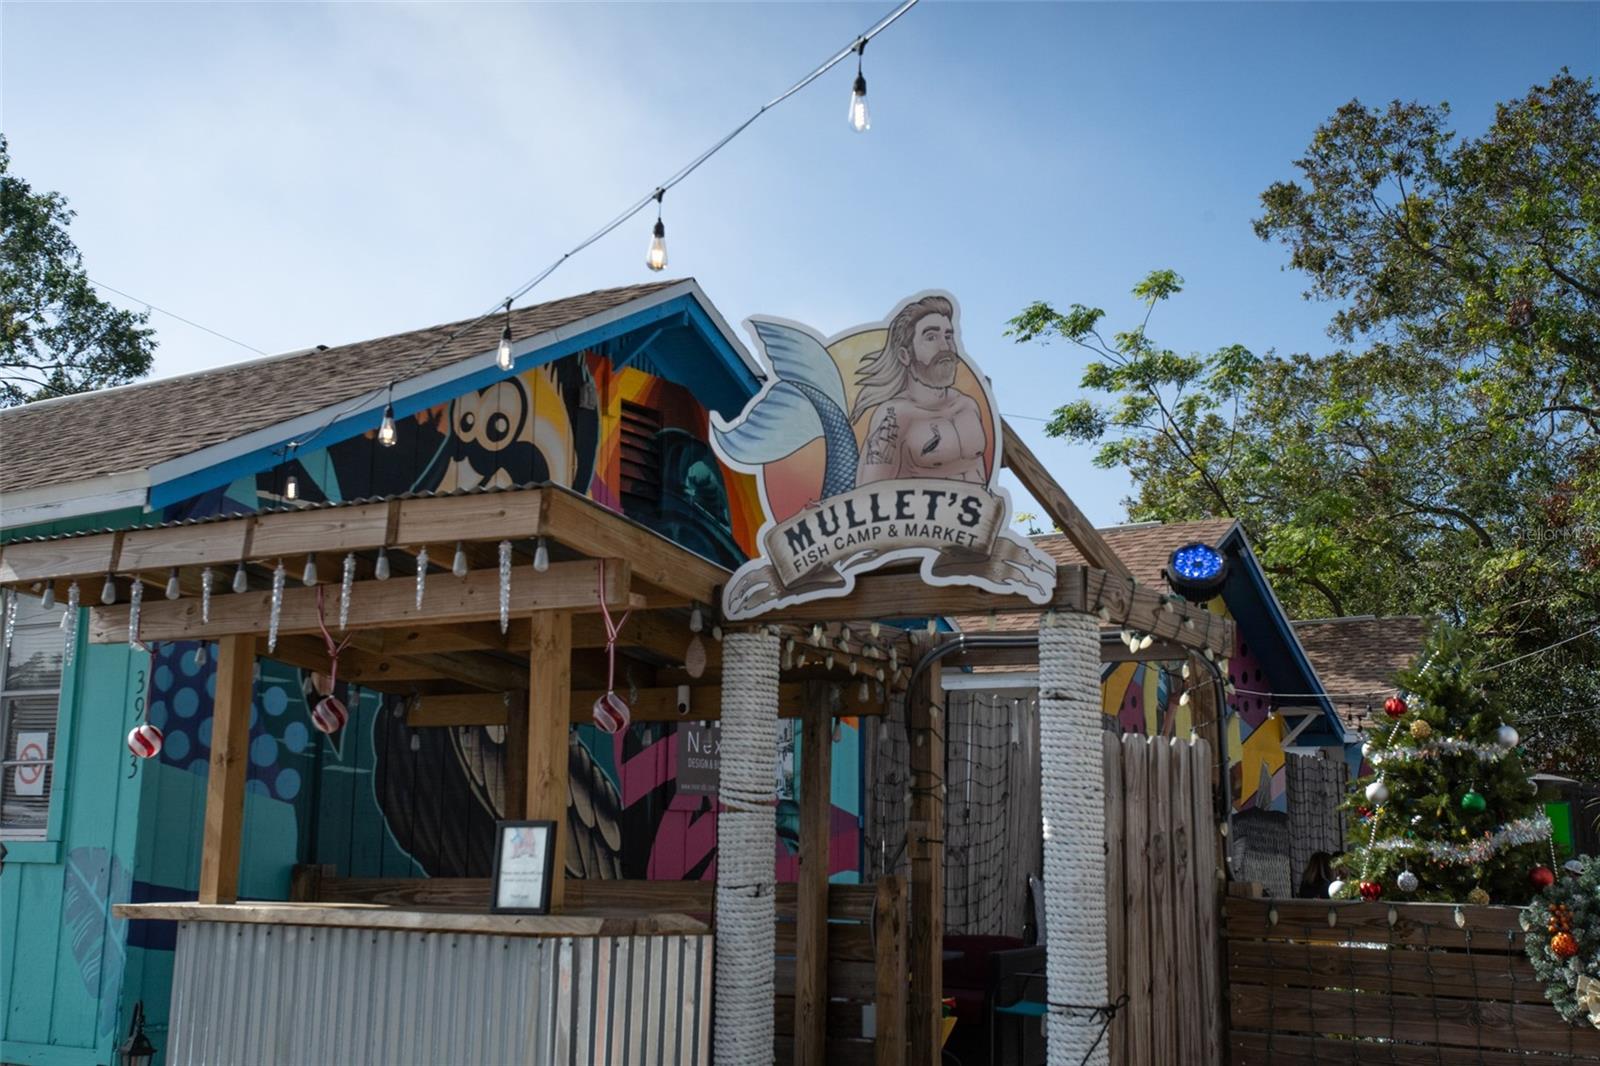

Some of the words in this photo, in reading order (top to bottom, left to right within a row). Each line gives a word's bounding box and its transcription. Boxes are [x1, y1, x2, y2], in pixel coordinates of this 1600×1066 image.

[783, 489, 982, 557] MULLET'S
[793, 543, 830, 574] FISH
[835, 525, 882, 551] CAMP
[888, 525, 898, 537] &
[904, 523, 979, 548] MARKET
[127, 670, 145, 779] 393
